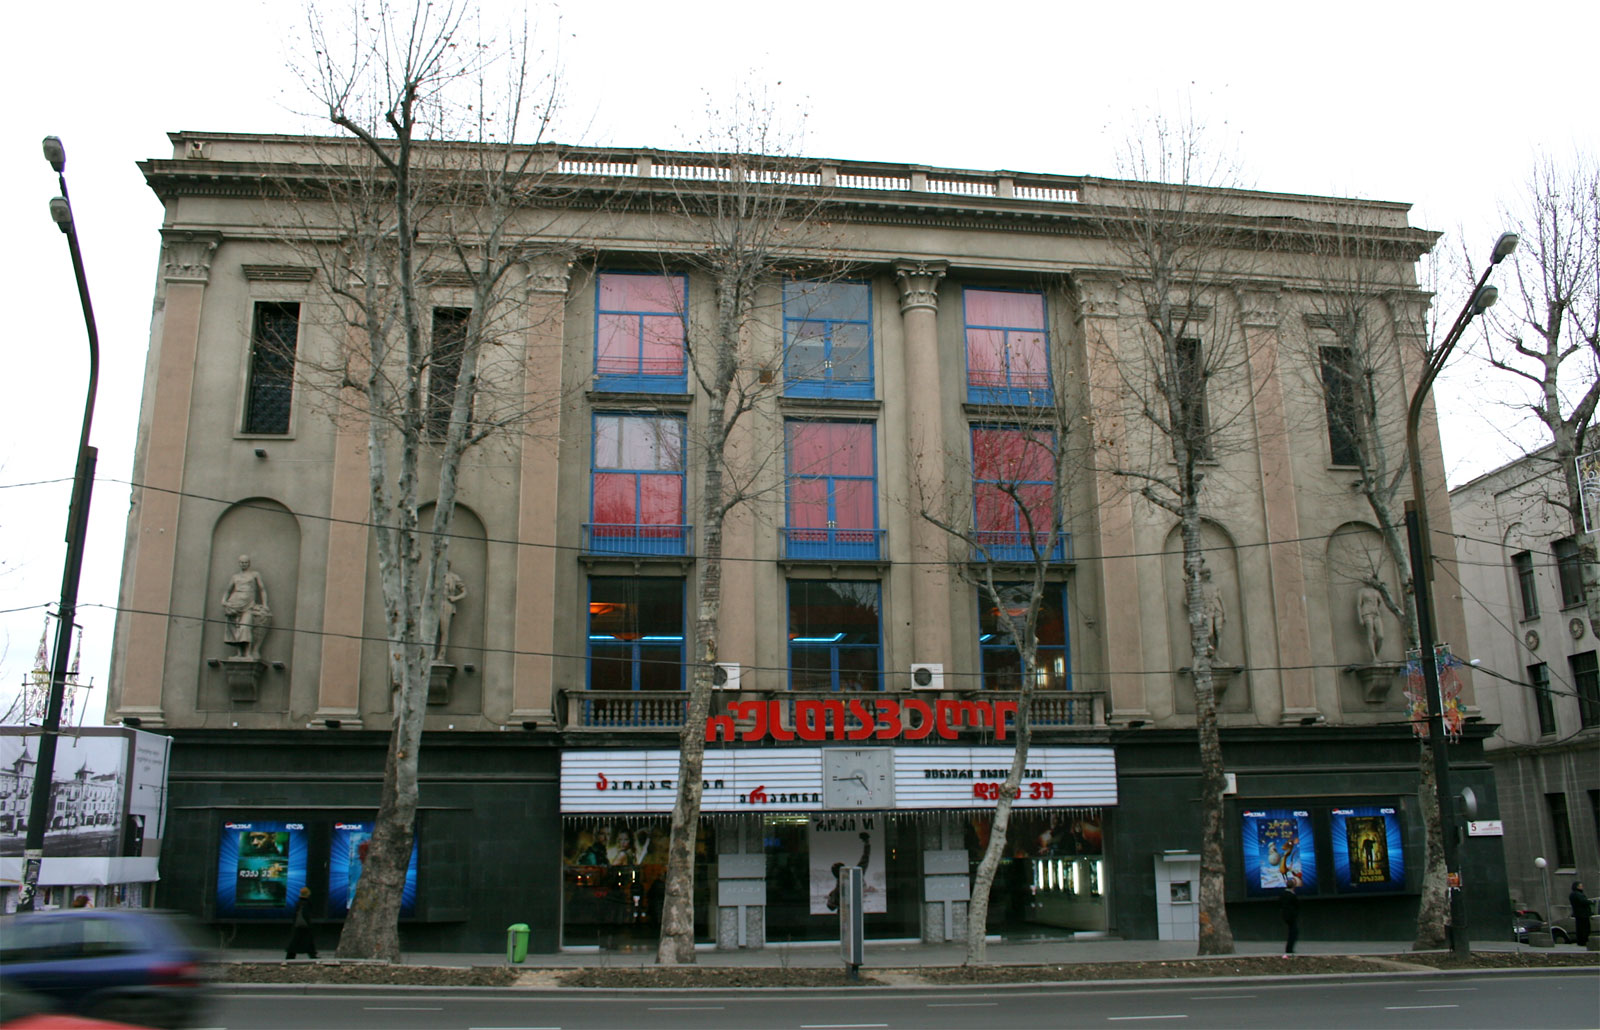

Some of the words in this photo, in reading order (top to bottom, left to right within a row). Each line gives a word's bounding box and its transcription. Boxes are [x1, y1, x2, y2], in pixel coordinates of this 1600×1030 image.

[739, 785, 819, 804] ერაგონი
[1030, 782, 1054, 800] ვუ
[1471, 823, 1477, 832] 5
